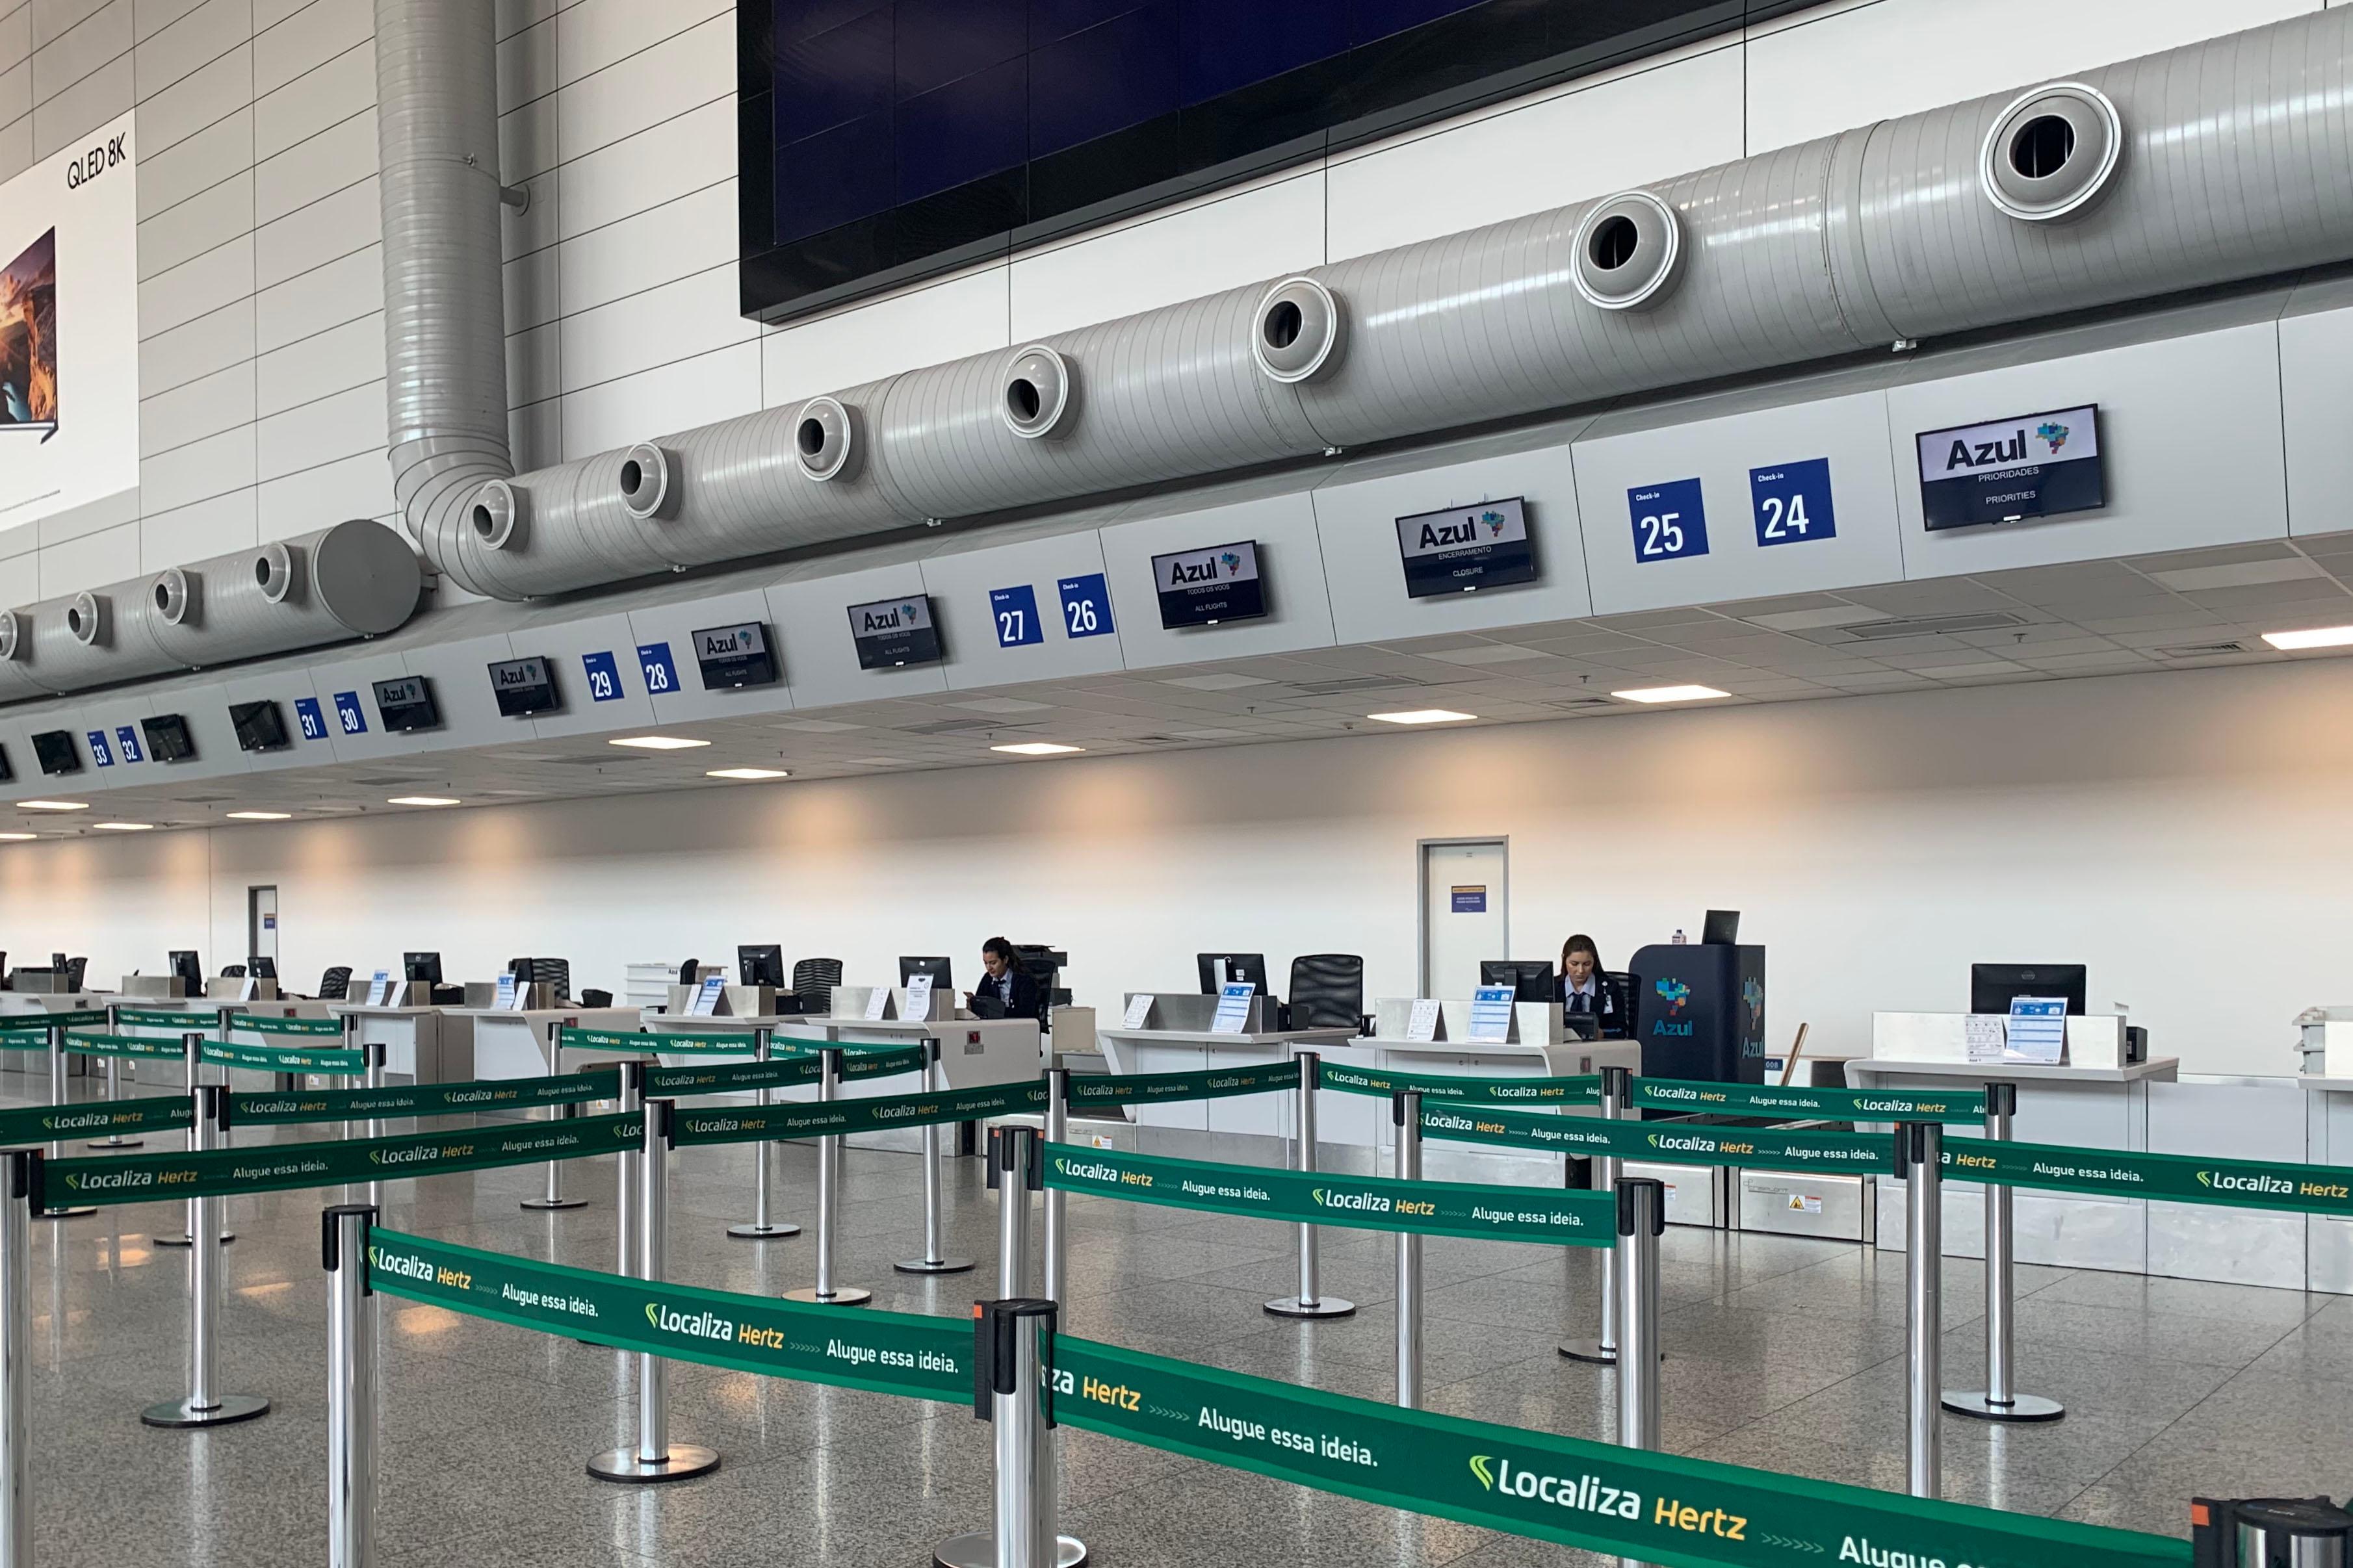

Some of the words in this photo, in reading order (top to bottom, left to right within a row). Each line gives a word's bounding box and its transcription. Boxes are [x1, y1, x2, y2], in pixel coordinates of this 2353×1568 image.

[68, 147, 105, 189] QLED
[109, 131, 126, 168] 8K
[1946, 430, 2027, 471] Azul
[1758, 472, 1784, 482] Check-in
[1978, 466, 2040, 483] PRIORIDADES
[1635, 492, 1660, 502] Check-in
[1986, 491, 2036, 505] PRIORITIES
[1762, 495, 1809, 539] 24
[1420, 517, 1477, 549] Azul
[1640, 513, 1684, 556] 25
[1438, 546, 1492, 560] ENCERRAMENTO
[1171, 557, 1218, 585] Azul
[1453, 567, 1484, 577] CLOSURE
[1068, 600, 1097, 633] 26
[1205, 602, 1227, 610] FLIGHTS
[864, 608, 900, 632] Azul
[1000, 610, 1024, 642] 27
[707, 633, 739, 655] Azul
[500, 666, 526, 686] Azul
[591, 671, 612, 697] 29
[645, 663, 668, 690] 28
[383, 685, 407, 703] Azul
[302, 713, 318, 736] 31
[341, 708, 358, 732] 30
[93, 744, 108, 764] 33
[122, 740, 138, 760] 32
[1653, 1020, 1693, 1036] Azul
[591, 1035, 608, 1044] Localiza
[673, 1039, 694, 1047] Localiza
[770, 1042, 785, 1050] ocaliza
[1742, 1036, 1764, 1059] Azul
[662, 1075, 695, 1086] Localiza
[696, 1075, 716, 1084] Hertz
[732, 1073, 751, 1082] Alugue
[1084, 1085, 1113, 1096] Localiza
[1115, 1086, 1132, 1094] Hertz
[1213, 1077, 1239, 1088] Localiza
[1334, 1072, 1368, 1086] Localiza
[1370, 1079, 1390, 1089] Hertz
[1447, 1087, 1464, 1096] ideia.
[1497, 1086, 1537, 1097] Localiza
[1540, 1088, 1565, 1096] Hertz
[1586, 1087, 1600, 1097] Alug
[250, 1100, 297, 1113] Localiza
[300, 1101, 327, 1112] Hertz
[350, 1101, 376, 1111] Alugue
[378, 1099, 395, 1108] essa
[452, 1090, 491, 1103] Localiza
[494, 1091, 518, 1099] Hertz
[538, 1087, 560, 1098] Alugue
[577, 1084, 593, 1092] ideia.
[1653, 1086, 1696, 1100] Localiza
[1700, 1092, 1726, 1102] Hertz
[1749, 1096, 1777, 1107] Alugue
[1799, 1098, 1821, 1108] ideia.
[1863, 1099, 1912, 1112] Localiza
[1916, 1103, 1946, 1113] Hertz
[54, 1113, 109, 1129] Localiza
[112, 1112, 144, 1124] Hertz
[170, 1109, 192, 1119] Alug
[695, 1118, 738, 1132] Localiza
[741, 1119, 766, 1129] Hertz
[787, 1118, 811, 1128] Alugue
[829, 1114, 846, 1123] ideia.
[879, 1105, 915, 1118] Localiza
[918, 1105, 938, 1114] Hertz
[956, 1102, 977, 1112] Alugue
[991, 1098, 1006, 1107] ideia.
[1425, 1113, 1473, 1130] Localiza
[1476, 1122, 1505, 1134] Hertz
[1531, 1128, 1561, 1141] Alugue
[1564, 1131, 1584, 1142] essa
[1587, 1133, 1611, 1144] ideia.
[1658, 1134, 1716, 1152] Localiza
[1719, 1142, 1754, 1155] Hertz
[1784, 1146, 1821, 1160] Alugue
[1823, 1149, 1847, 1160] essa
[1850, 1148, 1878, 1161] ideia.
[81, 1170, 152, 1190] Localiza
[157, 1170, 198, 1185] Hertz
[233, 1168, 271, 1180] Alugue
[274, 1164, 298, 1174] essa
[301, 1161, 328, 1172] ideia.
[381, 1146, 438, 1164] Localiza
[442, 1144, 474, 1159] Hertz
[502, 1141, 533, 1152] Alugue
[535, 1138, 555, 1148] essa
[557, 1135, 579, 1146] ideia.
[1956, 1153, 1996, 1168] Hertz
[2033, 1163, 2075, 1177] Alugue
[2078, 1168, 2107, 1179] essa
[2110, 1168, 2144, 1183] ideia.
[2213, 1172, 2293, 1194] Localiza
[2300, 1182, 2349, 1198] Hertz
[1065, 1159, 1117, 1182] Localiza
[1121, 1170, 1153, 1187] Hertz
[1182, 1180, 1216, 1196] Alugue
[1218, 1186, 1241, 1197] essa
[1243, 1187, 1270, 1201] ideia.
[1325, 1189, 1390, 1212] Localiza
[1395, 1199, 1435, 1215] Hertz
[1472, 1207, 1514, 1224] Alugue
[1518, 1212, 1546, 1224] essa
[1550, 1211, 1584, 1226] ideia.
[378, 1247, 434, 1281] Localiza
[437, 1266, 471, 1290] Hertz
[502, 1283, 539, 1306] Alugue
[541, 1294, 566, 1311] essa
[569, 1295, 599, 1317] ideia.
[659, 1305, 733, 1341] Localiza
[738, 1324, 784, 1349] Hertz
[826, 1339, 876, 1365] Alugue
[880, 1349, 915, 1369] essa
[918, 1349, 959, 1374] ideia.
[1083, 1376, 1141, 1411] Hertz
[1198, 1406, 1265, 1441] Alugue
[1271, 1428, 1314, 1454] essa
[1321, 1433, 1378, 1467] ideia.
[1498, 1459, 1641, 1520] Localiza
[1654, 1497, 1747, 1541] Hertz
